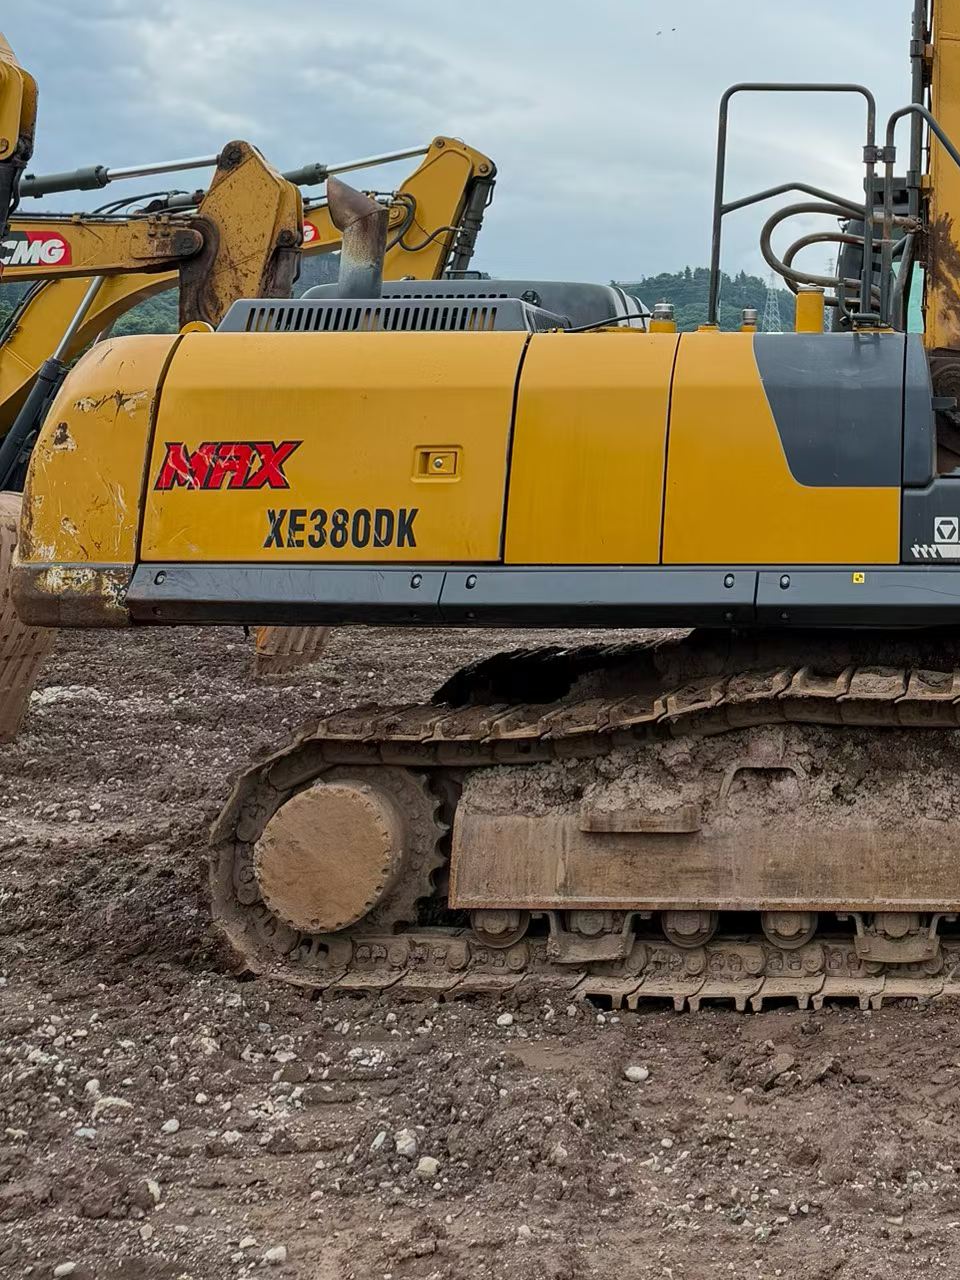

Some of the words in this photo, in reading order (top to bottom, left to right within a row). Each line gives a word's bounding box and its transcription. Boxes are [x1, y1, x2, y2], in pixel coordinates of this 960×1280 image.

[0, 239, 65, 265] CMG
[154, 440, 304, 490] MAX
[263, 508, 419, 548] XE380DK
